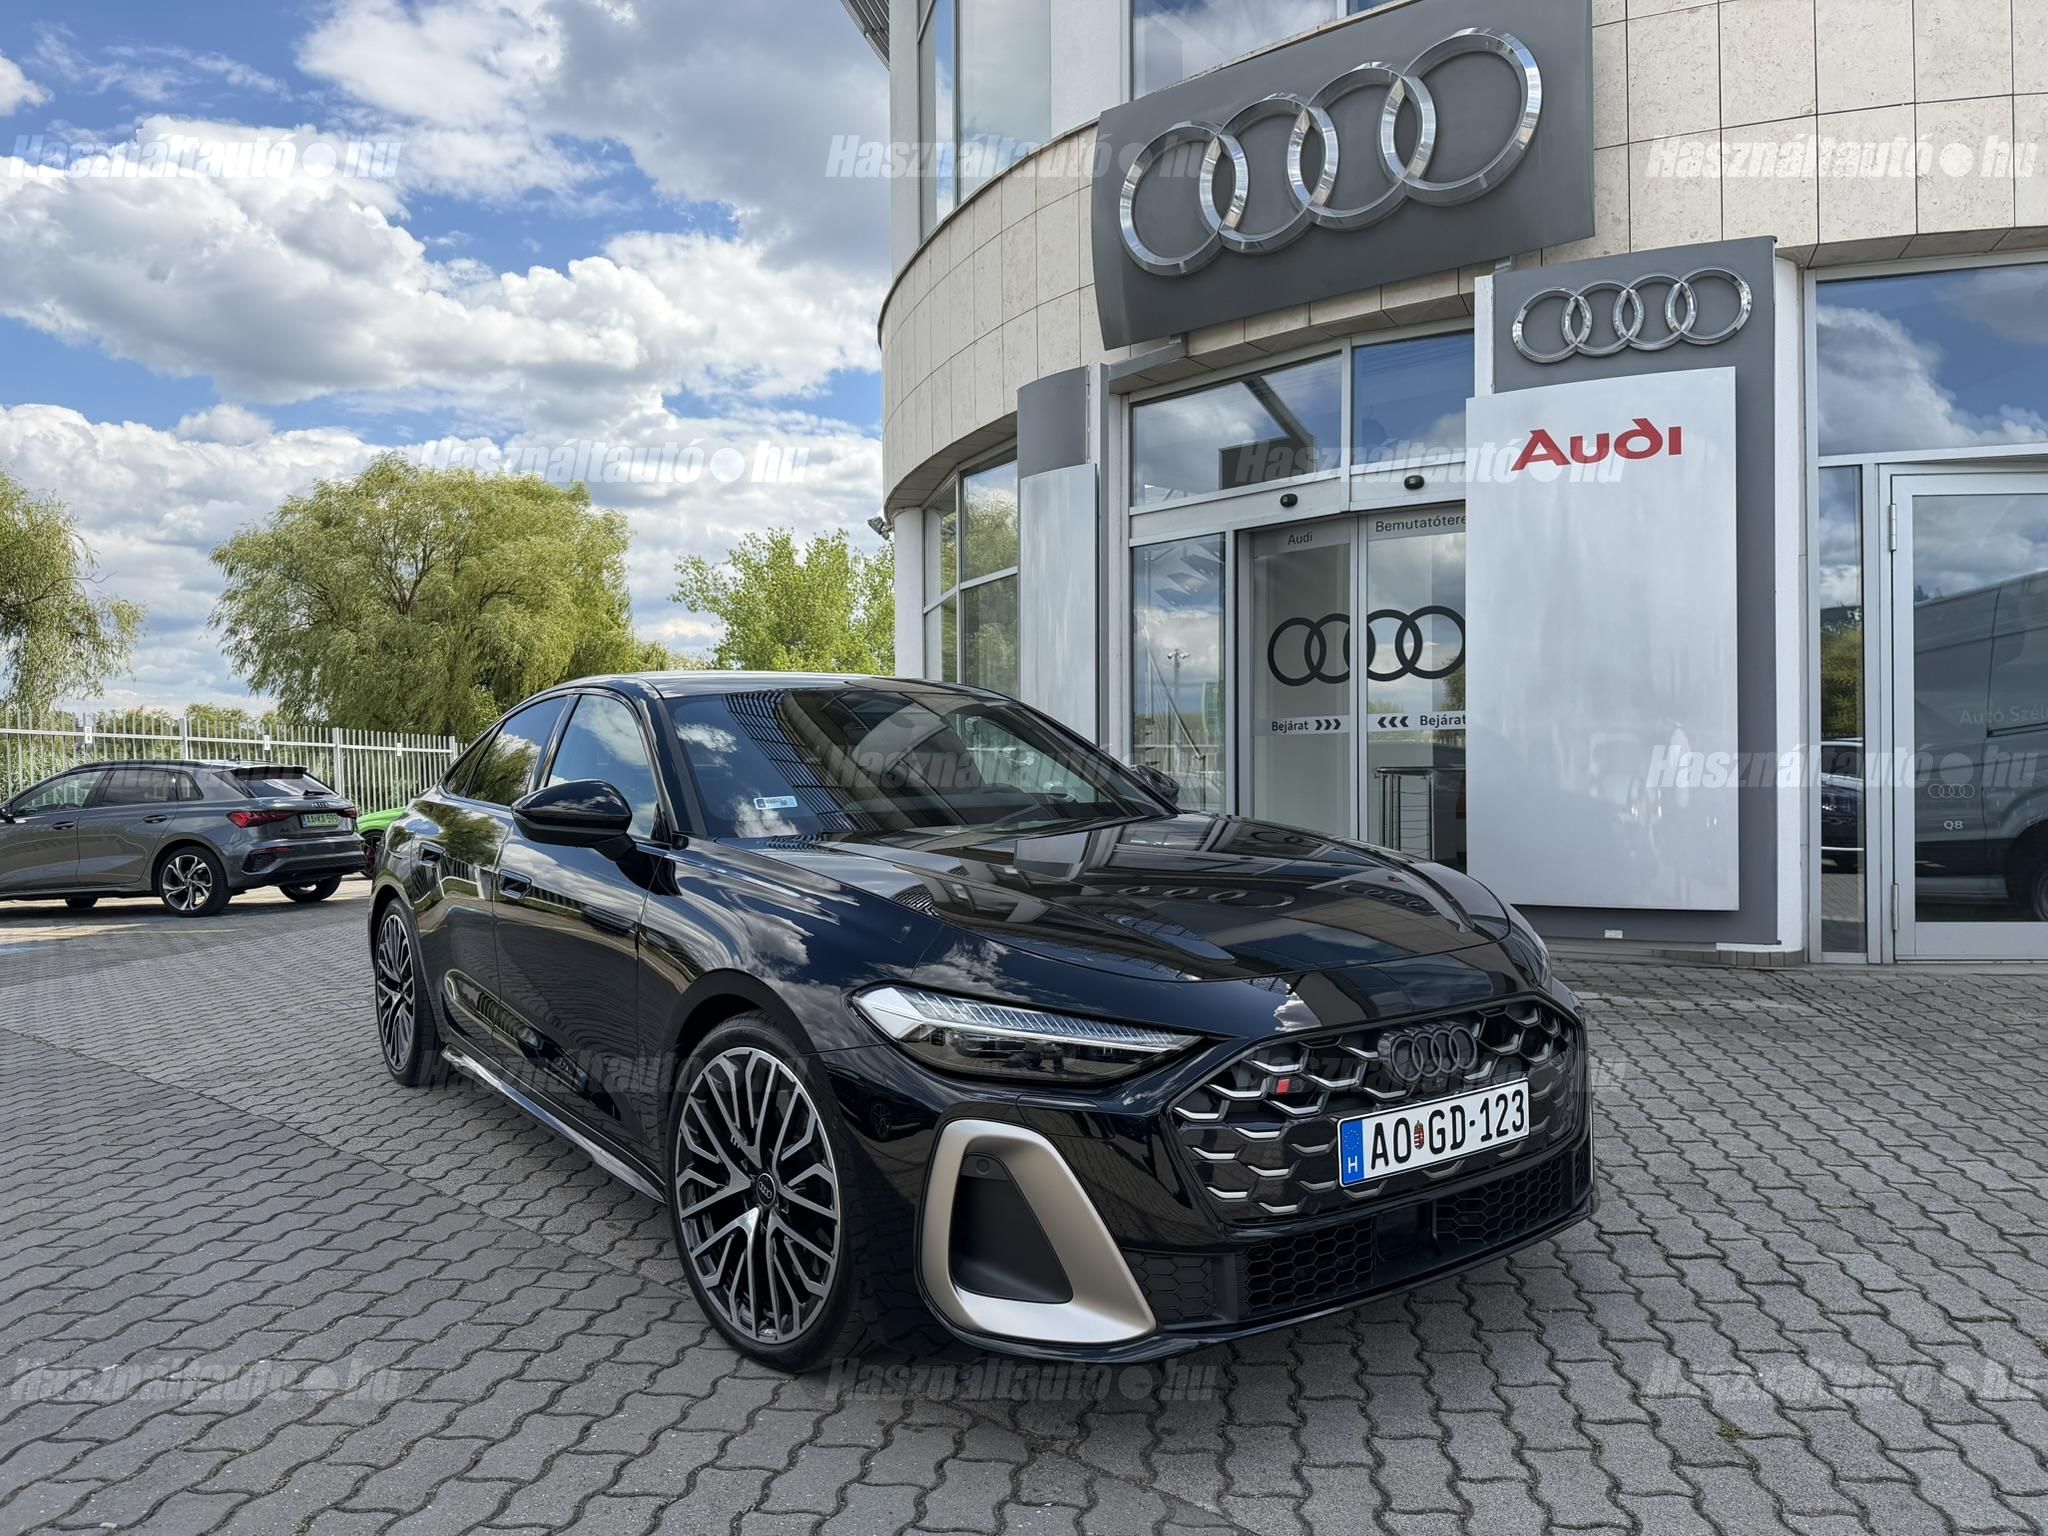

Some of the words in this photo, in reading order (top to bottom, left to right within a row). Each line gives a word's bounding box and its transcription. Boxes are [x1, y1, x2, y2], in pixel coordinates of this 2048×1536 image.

[1511, 418, 1682, 472] Audi
[1287, 531, 1313, 546] Audi
[1271, 720, 1309, 734] Bejárat
[1419, 714, 1466, 727] Bejárat
[1943, 820, 1964, 830] Q8
[1347, 1155, 1358, 1174] H
